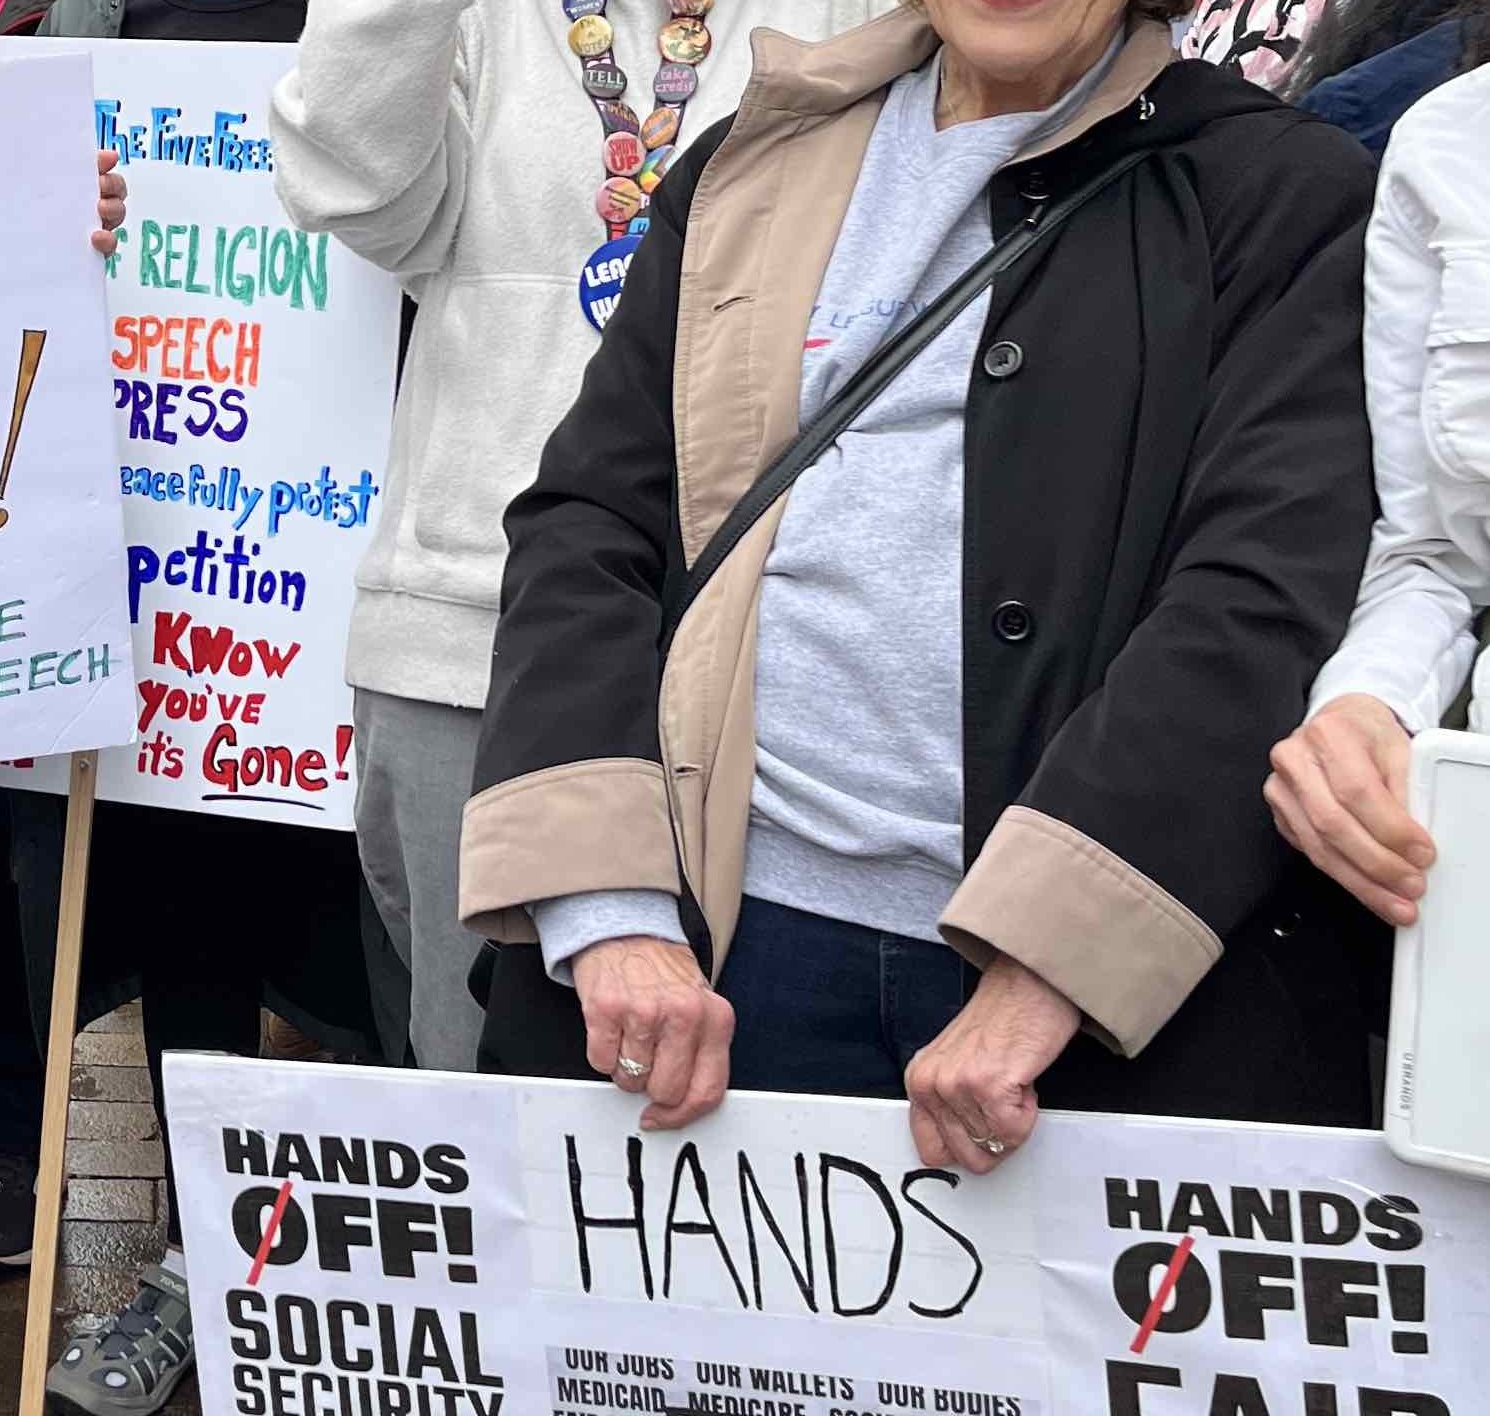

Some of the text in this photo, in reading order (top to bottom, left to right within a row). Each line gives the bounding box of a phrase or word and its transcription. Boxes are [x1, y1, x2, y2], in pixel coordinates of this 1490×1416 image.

[588, 70, 624, 85] TELL
[213, 111, 273, 172] FREE
[611, 155, 640, 172] UP
[140, 219, 328, 311] RELIGION
[112, 316, 262, 386] SPEECH
[114, 379, 249, 445] PRESS
[127, 530, 306, 623] petition
[222, 1126, 470, 1193] HANDS
[231, 1186, 478, 1284] OFF!
[564, 1133, 984, 1319] HANDS
[1105, 1177, 1424, 1251] HANDS
[1113, 1241, 1429, 1354] OFF!
[225, 1288, 503, 1388] SOCIAL
[233, 1363, 503, 1416] SECURITY
[557, 1377, 667, 1413] MEDICAID
[565, 1348, 1021, 1416] OUR JOBS OUR WALLETS OUR BODIES
